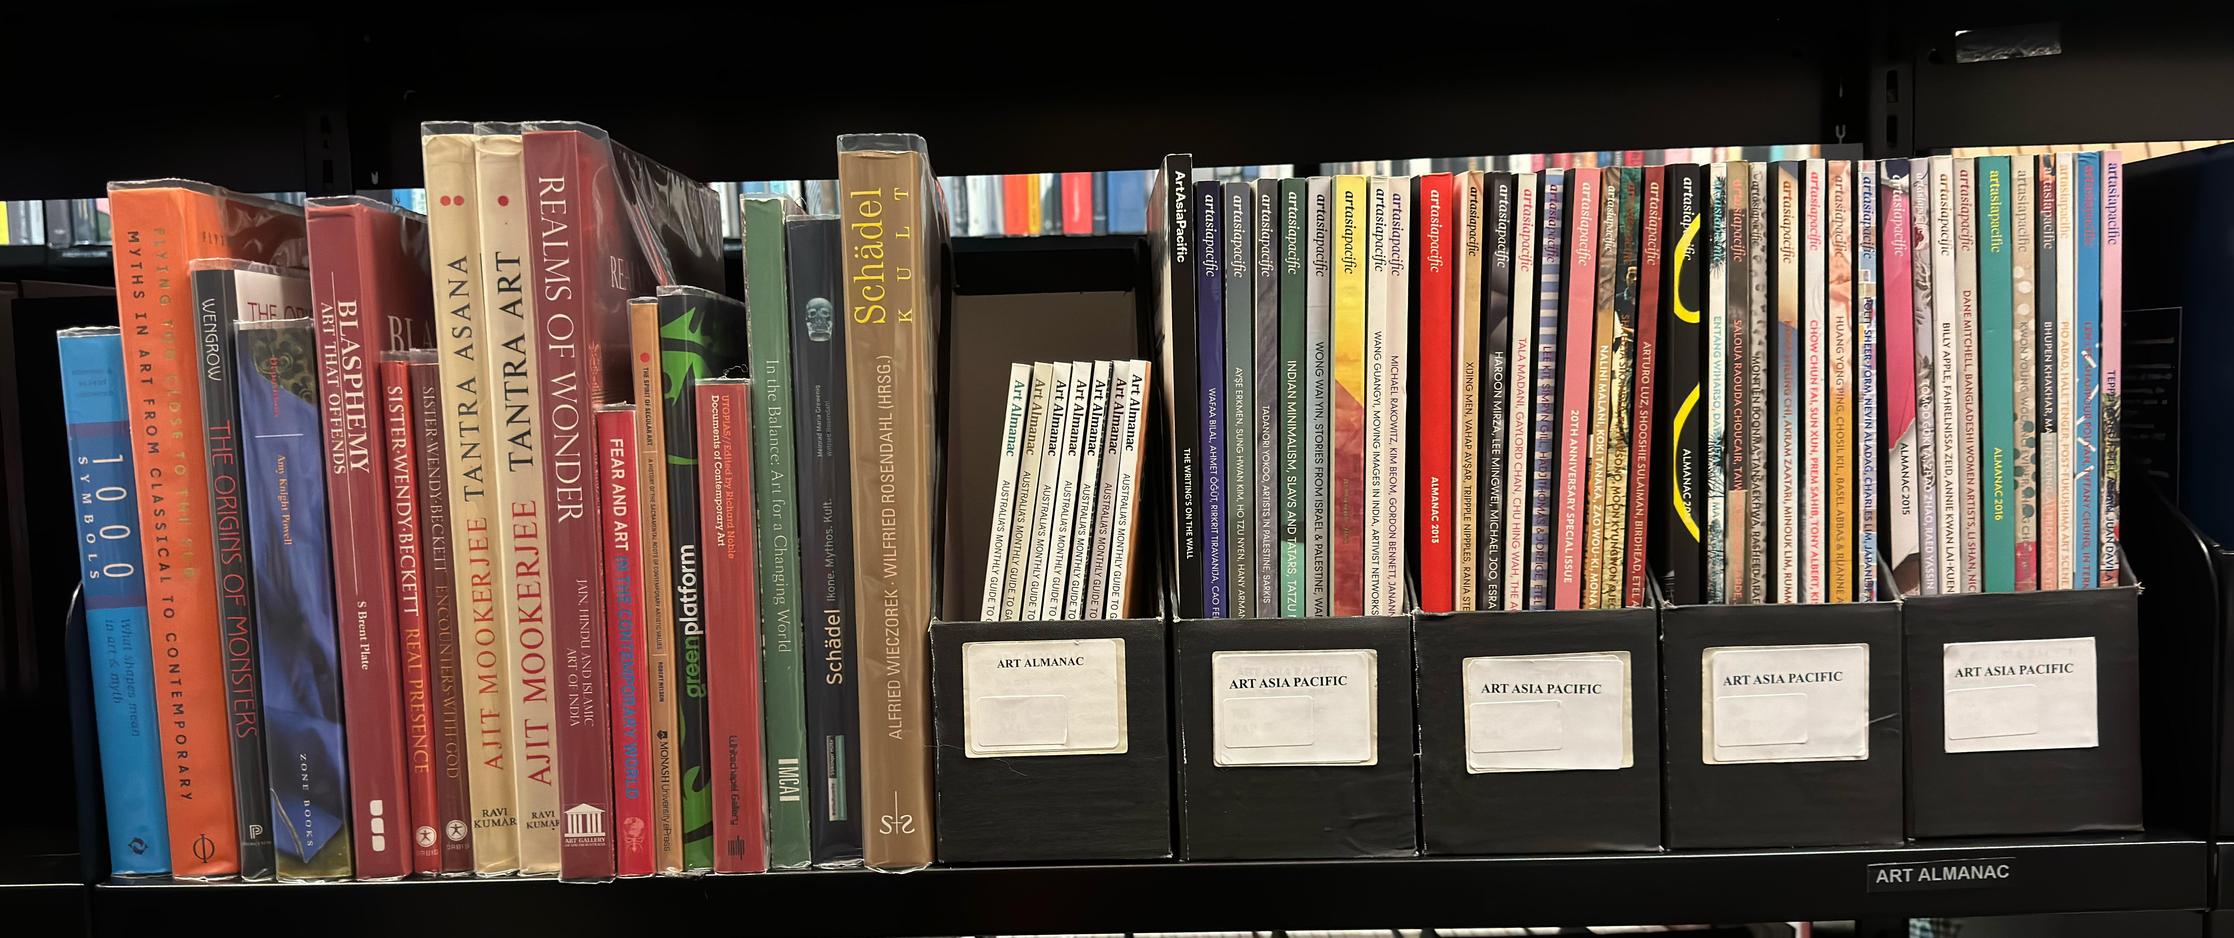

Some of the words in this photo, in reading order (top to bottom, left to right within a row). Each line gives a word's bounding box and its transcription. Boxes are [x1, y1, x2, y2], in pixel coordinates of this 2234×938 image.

[1175, 171, 1187, 263] ArtAsiaPacific
[1342, 191, 1356, 274] artasiapacific
[1372, 189, 1386, 272] artasiapacific
[1428, 190, 1442, 272] artasiapacific
[1494, 185, 1509, 268] artasiapacific
[1577, 182, 1592, 266] artasiapacific
[1809, 172, 1819, 251] artasiapacific
[1988, 170, 2002, 253] artasiapacific
[538, 176, 573, 301] REALMS
[1203, 194, 1217, 277] artasiapacific
[1231, 195, 1245, 278] artasiapacific
[1259, 194, 1273, 277] artasiapacific
[1285, 192, 1300, 275] artasiapacific
[1313, 194, 1327, 277] artasiapacific
[1389, 194, 1403, 276] artasiapacific
[128, 231, 145, 299] MYTHS
[851, 190, 886, 323] Schädel
[894, 188, 912, 322] KULT
[495, 251, 524, 319] ART
[135, 313, 148, 334] IN
[320, 302, 336, 336] ART
[447, 256, 474, 361] ASANA
[201, 298, 221, 381] WENGROW
[546, 314, 576, 358] OF
[1810, 320, 1818, 353] CHOW
[1942, 322, 1951, 348] BILLY
[139, 350, 153, 385] ART
[324, 342, 339, 384] THAT
[766, 361, 780, 374] In
[877, 356, 893, 409] (HRSG.)
[1287, 361, 1297, 398] INDIAN
[1810, 355, 1818, 384] CHUN
[1942, 351, 1951, 383] APPLE,
[337, 300, 370, 473] BLASPHEMY
[500, 334, 534, 472] TANTRA
[767, 378, 780, 402] the
[1013, 380, 1025, 402] Art
[1054, 380, 1066, 402] Art
[1093, 380, 1105, 402] Art
[1130, 374, 1143, 396] Art
[1809, 387, 1818, 405] FAI,
[143, 399, 160, 454] FROM
[209, 420, 233, 464] THE
[328, 394, 346, 474] OFFENDS
[455, 377, 484, 502] TANTRA
[711, 395, 720, 448] Documents
[768, 406, 782, 466] Balance:
[1006, 404, 1021, 456] Almanac
[1048, 405, 1063, 456] Almanac
[1087, 404, 1102, 456] Almanac
[1125, 398, 1140, 451] Almanac
[1286, 402, 1297, 472] MINIMALISM,
[1570, 410, 1579, 436] 20TH
[275, 455, 288, 479] Amy
[551, 371, 585, 523] WONDER
[610, 439, 624, 481] FEAR
[713, 452, 721, 460] of
[877, 412, 896, 503] ROSENDAHL
[1900, 443, 1909, 492] ALMANAC
[723, 477, 733, 489] by
[771, 471, 784, 494] Art
[1184, 465, 1192, 506] WRITING'S
[1287, 476, 1297, 508] SLAVS
[1566, 439, 1578, 510] ANNIVERSARY
[1994, 448, 2003, 496] ALMANAC
[93, 454, 135, 578] 1000
[277, 480, 291, 511] Knight
[612, 485, 628, 517] AND
[714, 462, 725, 530] Contemporary
[725, 491, 736, 528] Richard
[773, 499, 784, 517] for
[823, 499, 836, 523] Kult.
[1118, 473, 1131, 525] AUSTRALIA'S
[1185, 508, 1192, 519] ON
[1431, 477, 1439, 521] ALMANAC
[1901, 495, 1910, 515] 2015
[1994, 499, 2003, 520] 2016
[78, 457, 100, 579] SYMBOLS
[149, 467, 172, 583] CLASSICAL
[212, 475, 242, 565] ORIGINS
[281, 515, 293, 545] Powell
[614, 521, 628, 550] ART
[717, 532, 726, 546] Art
[774, 521, 783, 531] a
[1287, 511, 1297, 534] AND
[1565, 513, 1575, 553] SPECIAL
[615, 556, 628, 571] IN
[727, 530, 736, 559] Noble
[824, 526, 838, 569] Mythos.
[882, 509, 898, 578] WILFRIED
[1112, 528, 1125, 568] MONTHLY
[1286, 537, 1297, 577] TATARS,
[223, 574, 245, 606] OF
[616, 574, 631, 606] THE
[770, 535, 788, 605] Changing
[1110, 571, 1120, 597] GUIDE
[1564, 555, 1573, 583] ISSUE
[162, 596, 175, 619] TO
[466, 518, 499, 695] MOOKERJEE
[511, 501, 547, 702] MOOKERJEE
[576, 579, 591, 605] JAIN,
[1109, 600, 1117, 610] TO
[357, 611, 369, 641] Brent
[577, 609, 592, 648] HINDU
[777, 609, 791, 652] World
[884, 590, 901, 677] WIECZOREK
[360, 644, 371, 670] Plate
[406, 629, 421, 671] REAL
[566, 648, 578, 672] ART
[580, 652, 593, 678] AND
[824, 610, 843, 685] Schädel
[997, 658, 1021, 669] ART
[1025, 656, 1084, 668] ALMANAC
[228, 616, 257, 739] MONSTERS
[566, 675, 579, 690] OF
[616, 609, 637, 736] CONTEMPORARY
[1229, 678, 1260, 690] ART
[1264, 677, 1292, 688] ASIA
[1294, 676, 1348, 687] PACIFIC
[1481, 684, 1509, 695] ART
[1513, 684, 1541, 695] ASIA
[1546, 682, 1602, 695] PACIFIC
[1723, 675, 1750, 686] ART
[1755, 674, 1785, 685] ASIA
[1789, 671, 1843, 684] PACIFIC
[1955, 666, 1983, 677] ART
[1986, 665, 2013, 676] ASIA
[2018, 663, 2074, 674] PACIFIC
[165, 632, 193, 801] CONTEMPORARY
[568, 694, 581, 726] INDIA
[581, 682, 595, 727] ISLAMIC
[888, 680, 903, 739] ALFRIED
[409, 679, 429, 774] PRESENCE
[480, 708, 504, 771] AJIT
[300, 753, 309, 790] ZONE
[524, 719, 552, 786] AJIT
[623, 740, 639, 799] WORLD
[659, 741, 669, 782] MONASH
[778, 766, 800, 795] MCA
[303, 800, 313, 847] BOOKS
[474, 817, 517, 829] KUMAR
[482, 808, 508, 817] RAVI
[1876, 869, 1913, 883] ART
[1918, 865, 2010, 882] ALMANAC
